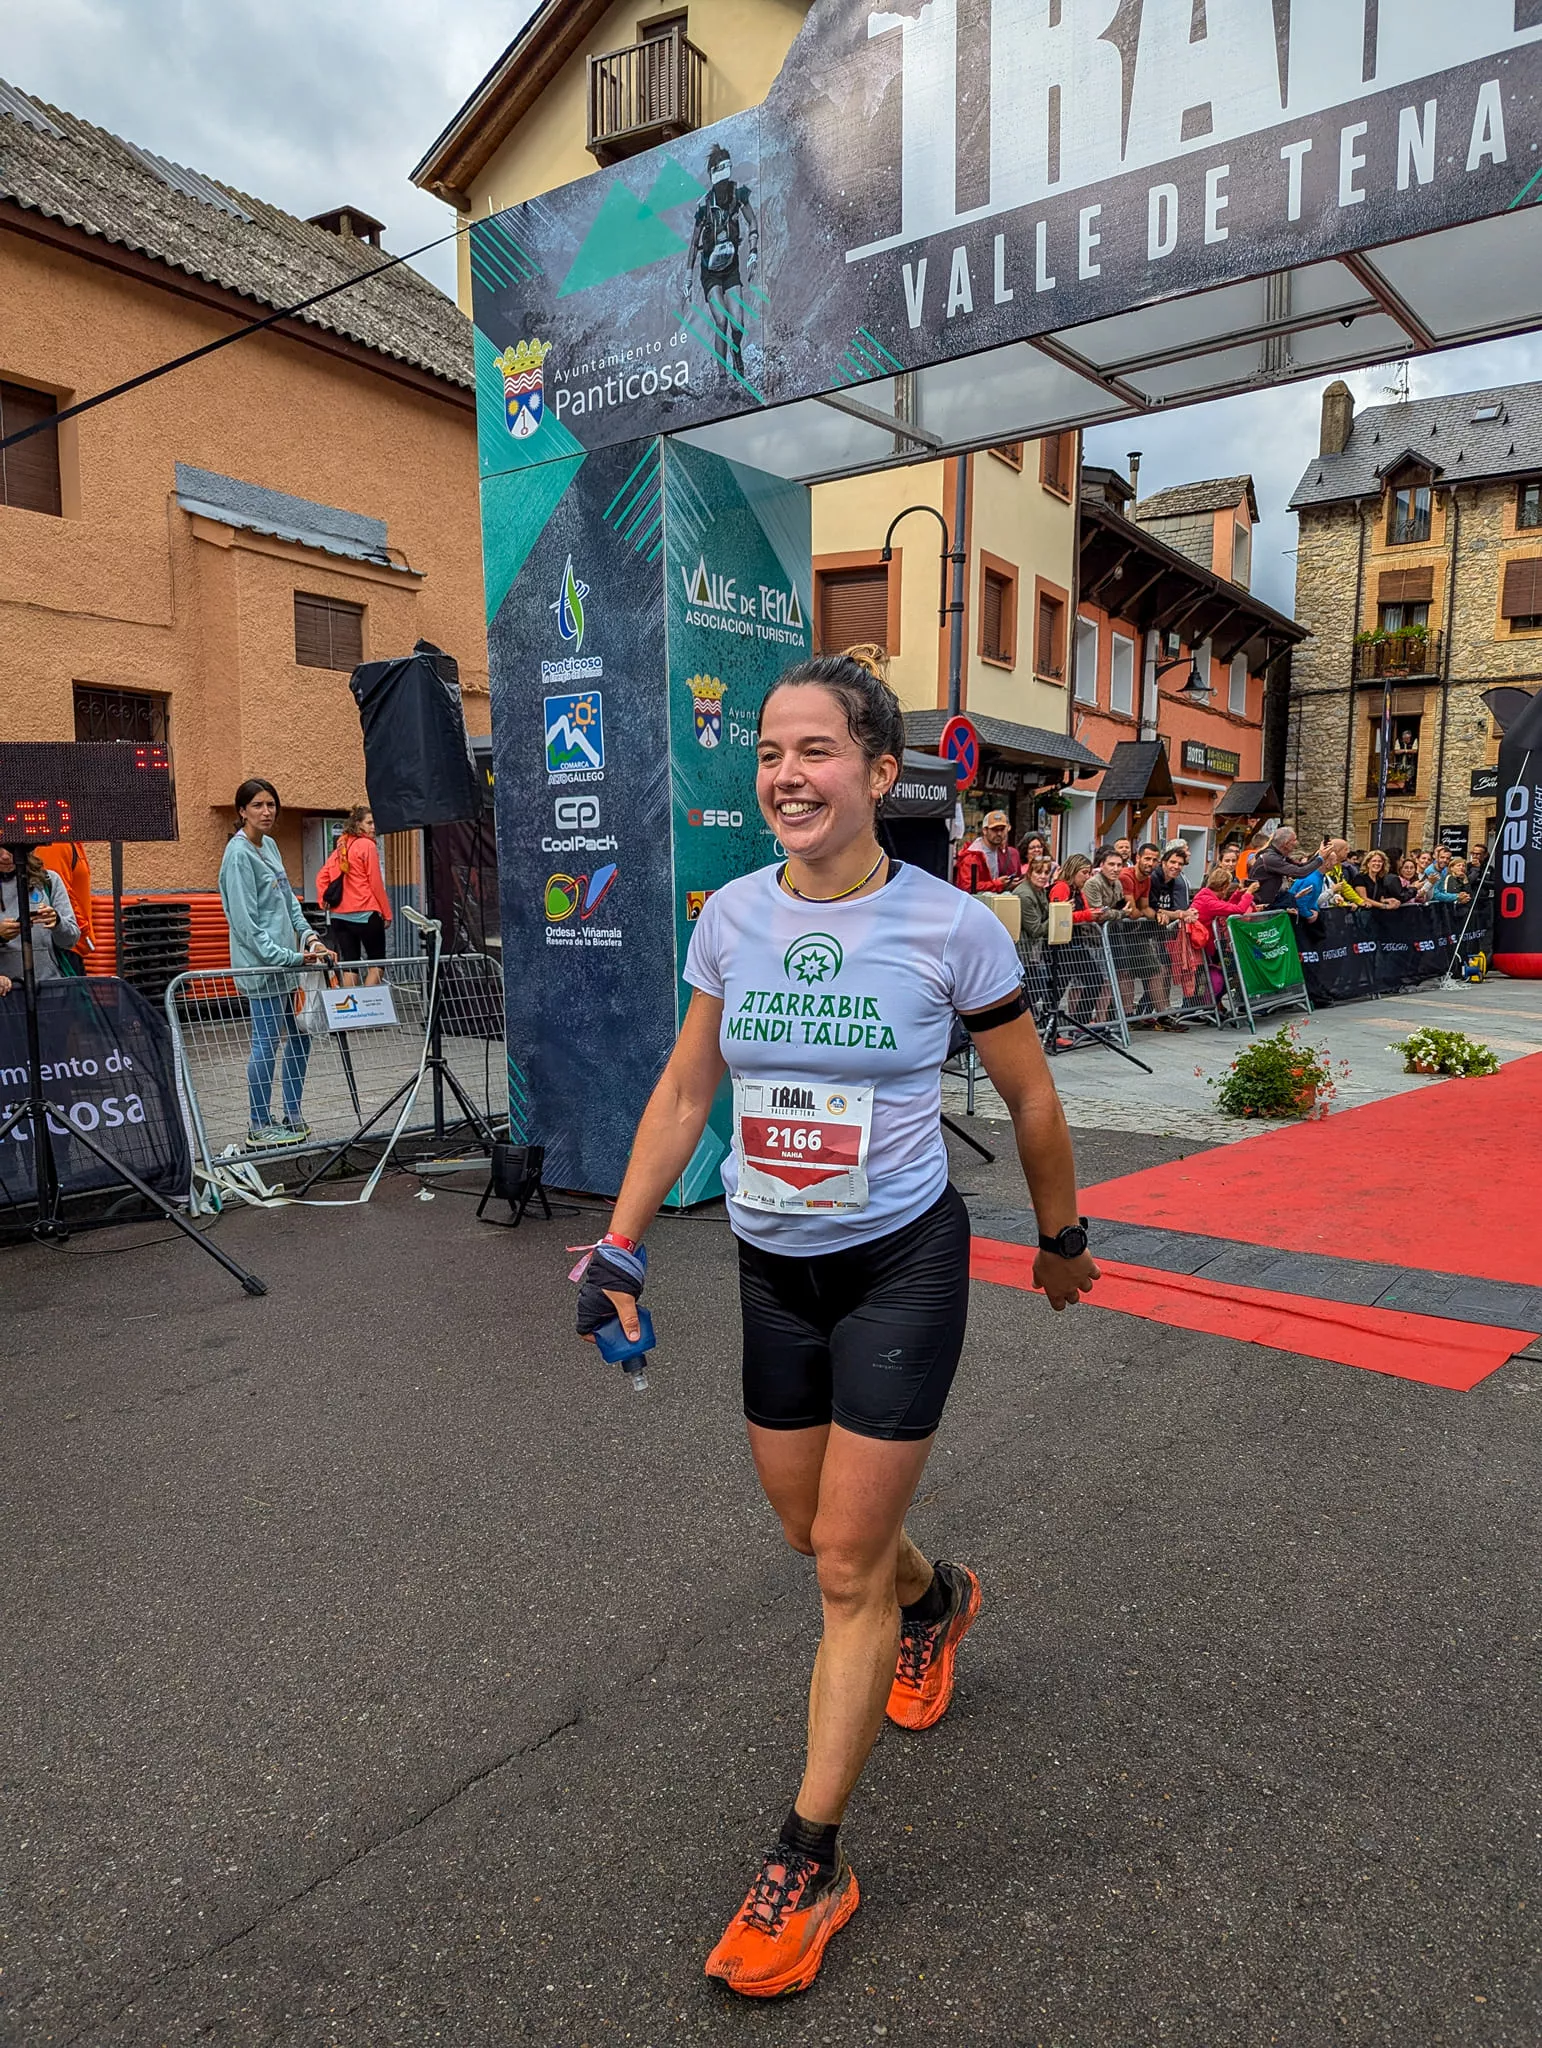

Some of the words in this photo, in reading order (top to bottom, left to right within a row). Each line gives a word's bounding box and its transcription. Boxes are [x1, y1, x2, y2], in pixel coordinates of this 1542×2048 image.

[901, 203, 1103, 330] VALLE
[1147, 164, 1231, 262] DE
[1280, 78, 1509, 222] TENA
[554, 339, 662, 383] Ayuntamiento
[669, 331, 688, 347] de
[555, 358, 690, 421] Panticosa
[681, 553, 737, 614] VALLE
[740, 594, 756, 618] DE
[685, 609, 754, 637] ASOCIACION
[756, 624, 805, 648] TURISTICA
[542, 656, 602, 673] Panticosa
[561, 761, 589, 769] COMARCA
[1187, 746, 1205, 764] HOTEL
[541, 835, 618, 852] CoolPack
[545, 926, 575, 937] Ordesa
[581, 926, 622, 938] Viñamala
[546, 937, 573, 946] Reserva
[585, 938, 591, 946] la
[593, 938, 622, 947] Biosfera
[738, 990, 882, 1021] ATARRABIA
[726, 1016, 792, 1043] MENDI
[801, 1020, 898, 1051] TALDEA
[0, 1056, 99, 1086] mento
[105, 1048, 133, 1073] de
[770, 1086, 816, 1110] TRAIL
[766, 1126, 822, 1151] 2166
[781, 1151, 803, 1159] NAHIA
